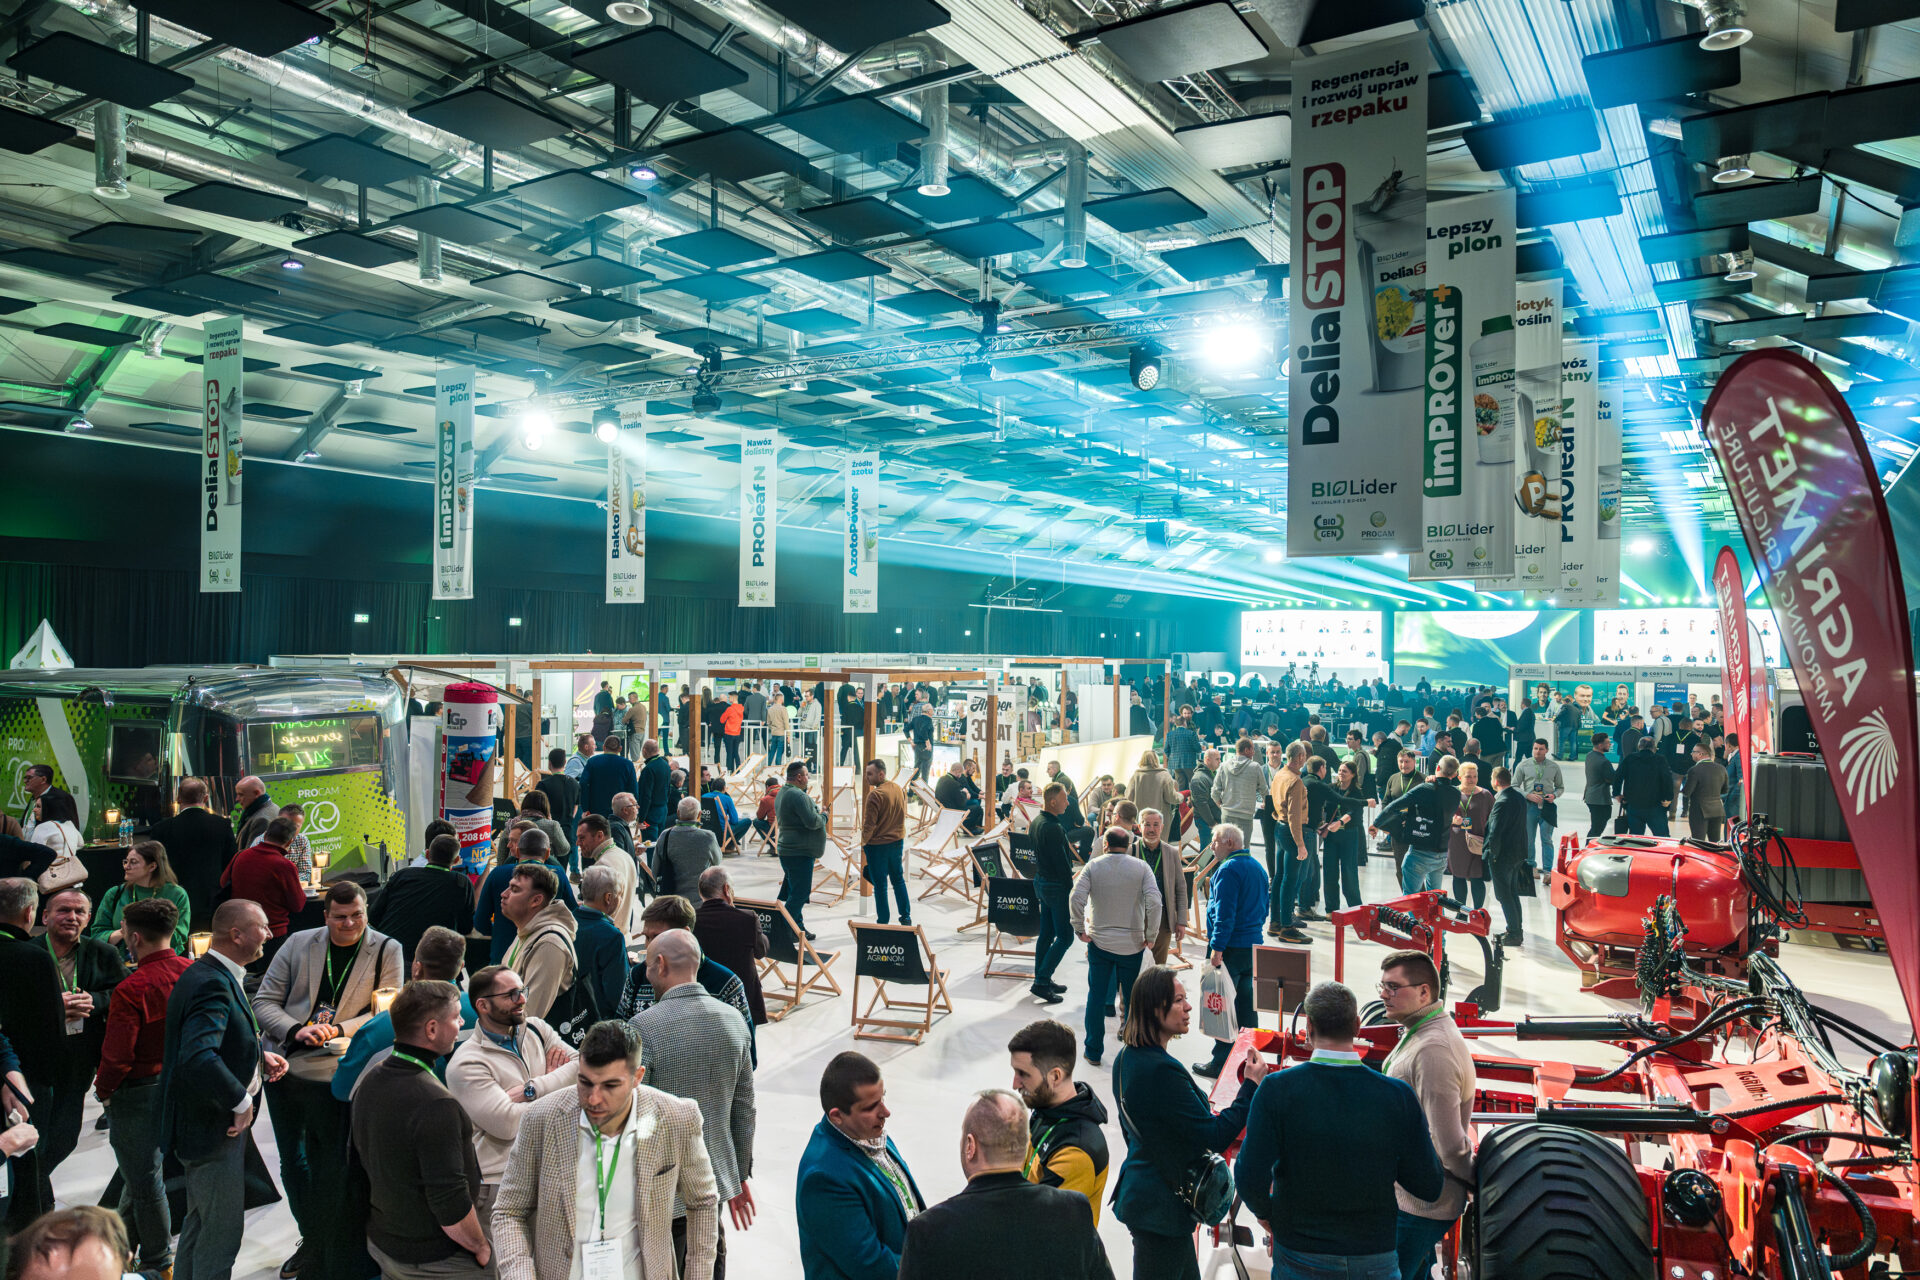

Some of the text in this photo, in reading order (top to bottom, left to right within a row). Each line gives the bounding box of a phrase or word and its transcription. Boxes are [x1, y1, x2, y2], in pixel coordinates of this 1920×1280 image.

[1311, 60, 1410, 92] Regeneracja
[1302, 75, 1419, 109] i rozwój upraw
[1311, 96, 1408, 128] rzepaku
[1426, 218, 1494, 241] Lepszy
[1448, 232, 1502, 260] plon
[1516, 296, 1555, 312] iotyk
[1516, 313, 1552, 326] oślin
[209, 346, 238, 360] rzepaku
[1562, 357, 1588, 370] wóz
[441, 382, 467, 394] Lepszy
[449, 392, 470, 406] plon
[746, 438, 772, 448] Nawóz
[744, 447, 775, 456] dolistny
[851, 468, 874, 477] azotu
[1322, 518, 1336, 526] BIO
[1321, 530, 1337, 538] GEN
[1361, 530, 1395, 538] PROCAM
[1515, 544, 1546, 555] Lider
[970, 696, 1012, 713] Aer
[997, 724, 1012, 741] AT
[7, 737, 41, 752] PROCAM
[297, 786, 340, 798] PROCAM
[997, 896, 1029, 905] ZAWÓD
[866, 944, 905, 955] ZAWÓD
[866, 954, 905, 962] AGRONOM
